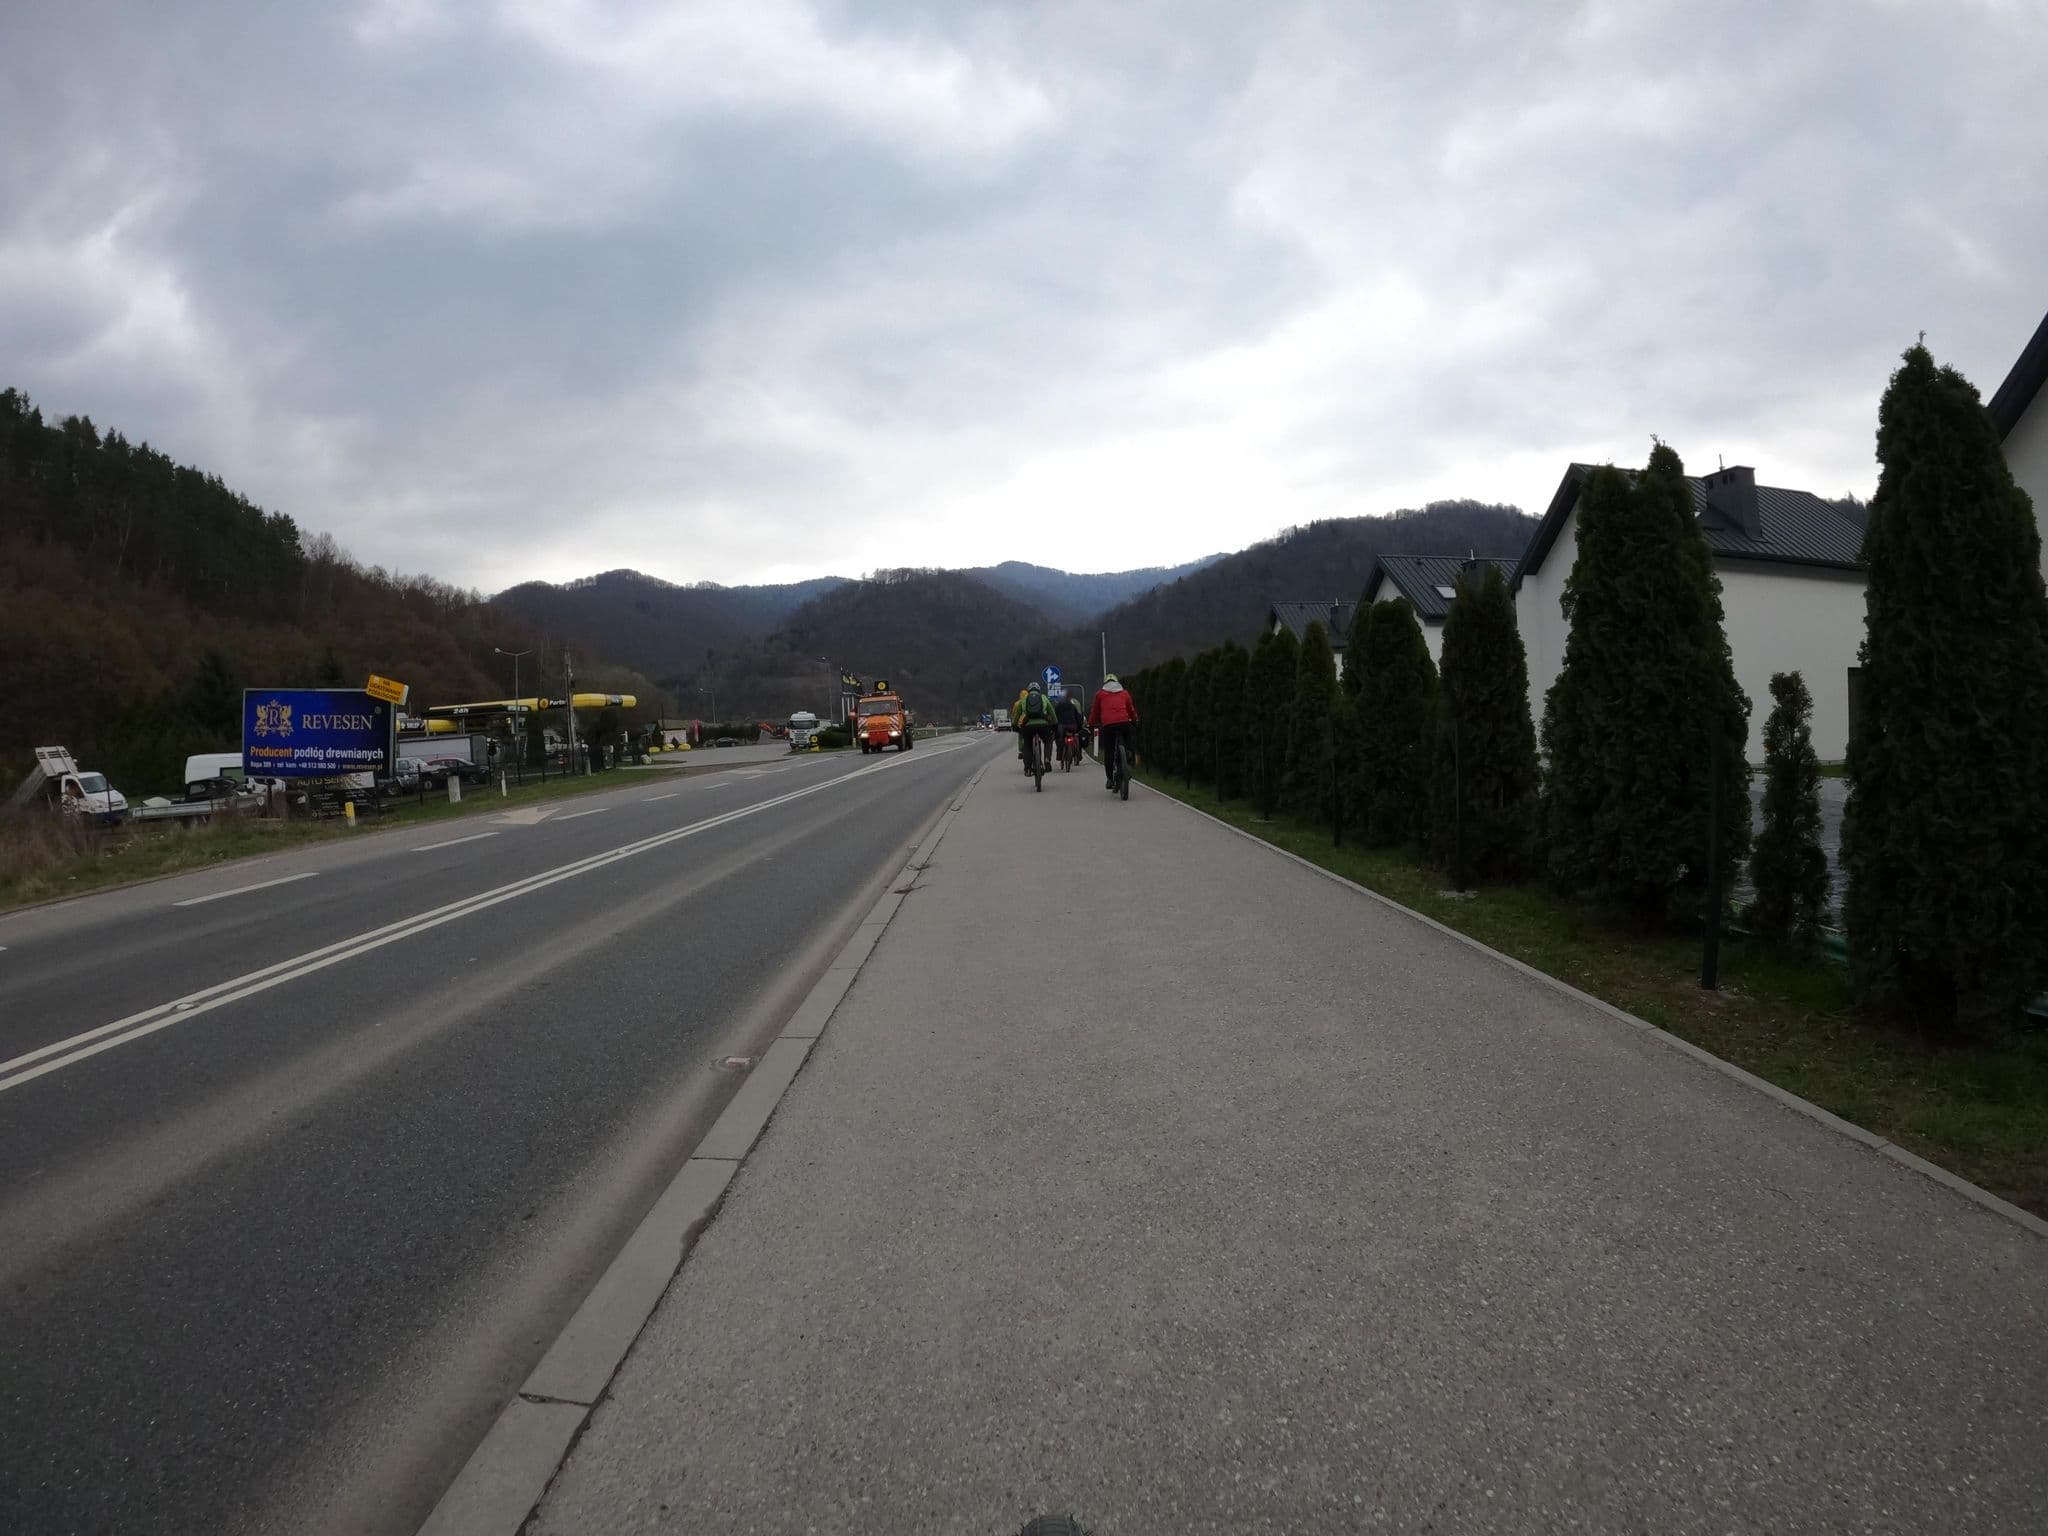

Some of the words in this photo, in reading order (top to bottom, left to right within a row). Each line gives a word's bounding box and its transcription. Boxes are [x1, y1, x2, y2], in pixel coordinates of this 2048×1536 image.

[270, 709, 278, 725] R
[302, 714, 374, 730] REVESEN
[250, 746, 293, 758] Producent
[294, 746, 324, 760] podłóg
[326, 747, 383, 761] drewnianych
